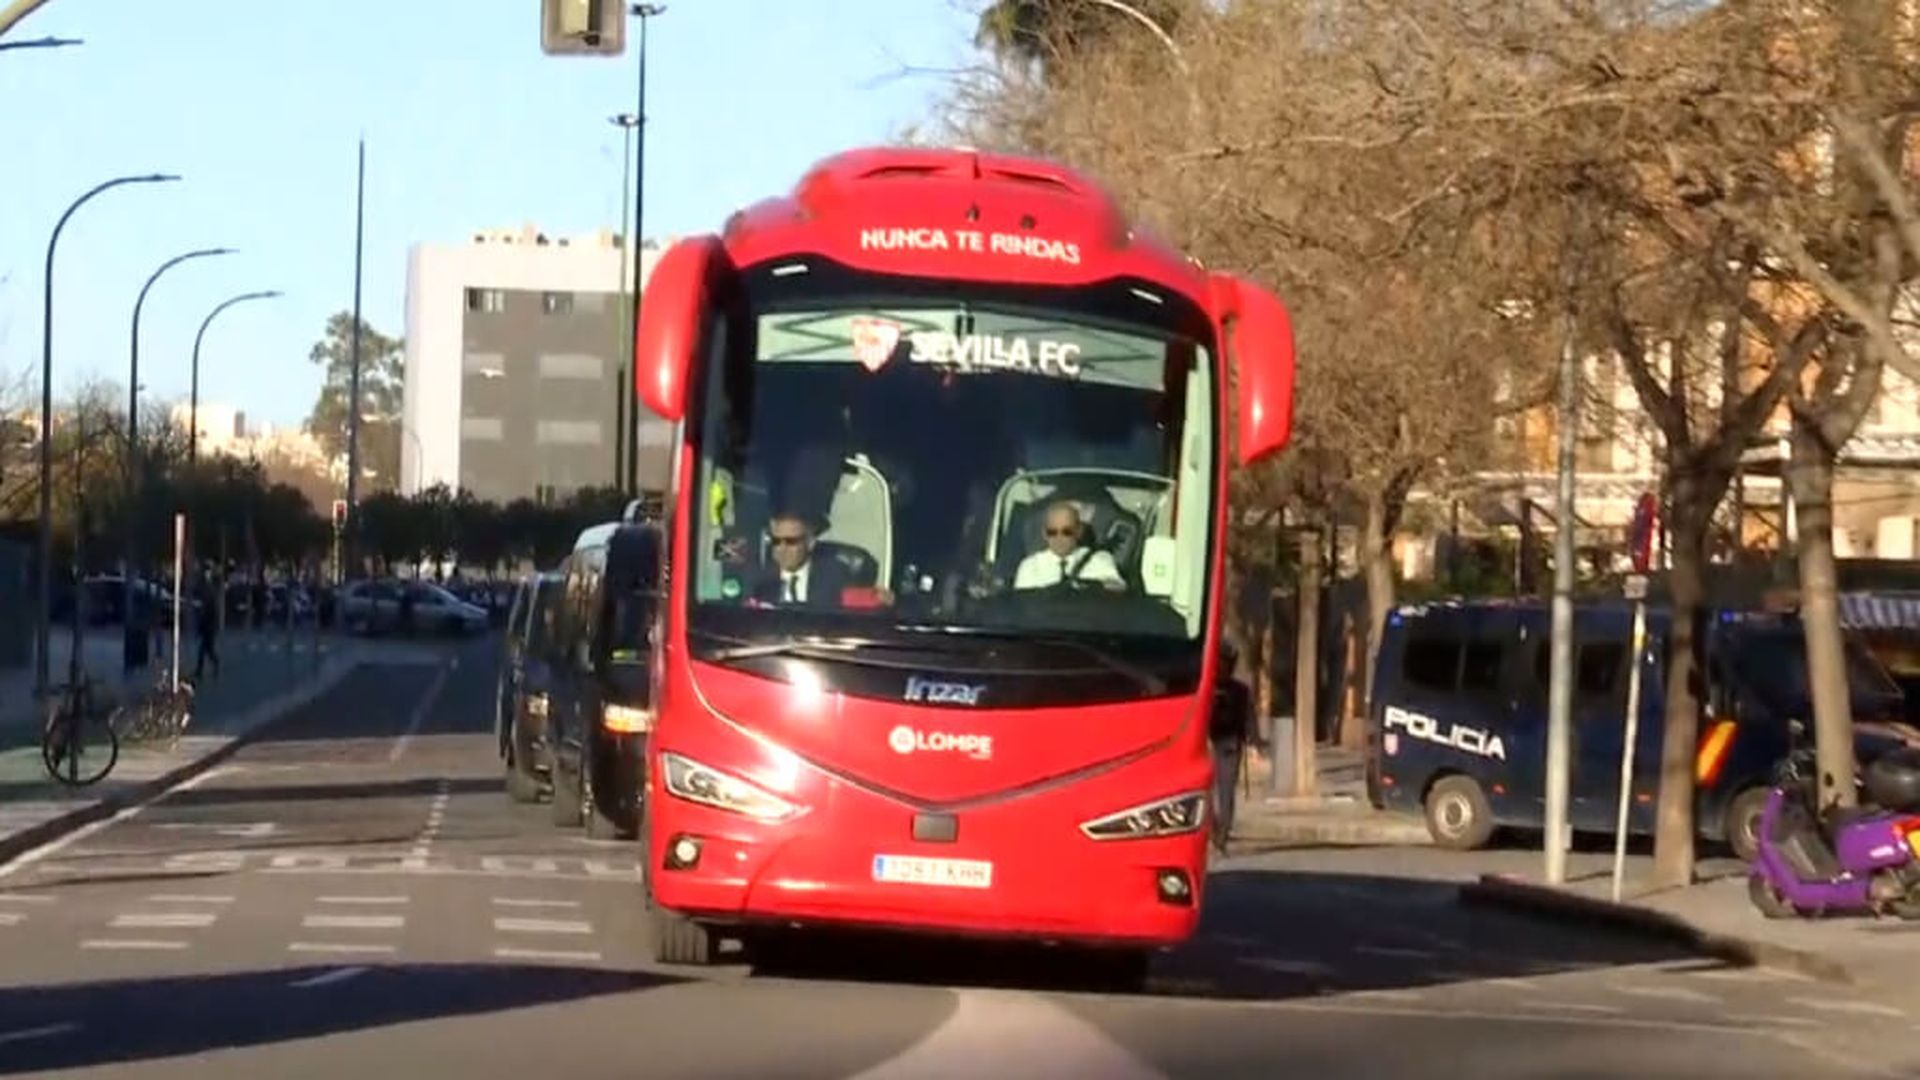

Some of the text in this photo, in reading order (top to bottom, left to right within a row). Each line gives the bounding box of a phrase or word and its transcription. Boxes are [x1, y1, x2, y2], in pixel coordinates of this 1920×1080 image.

[861, 229, 1081, 265] NUNCA TE RINDAS
[909, 330, 1081, 375] SEVILLA FC
[916, 731, 993, 754] LOMPE
